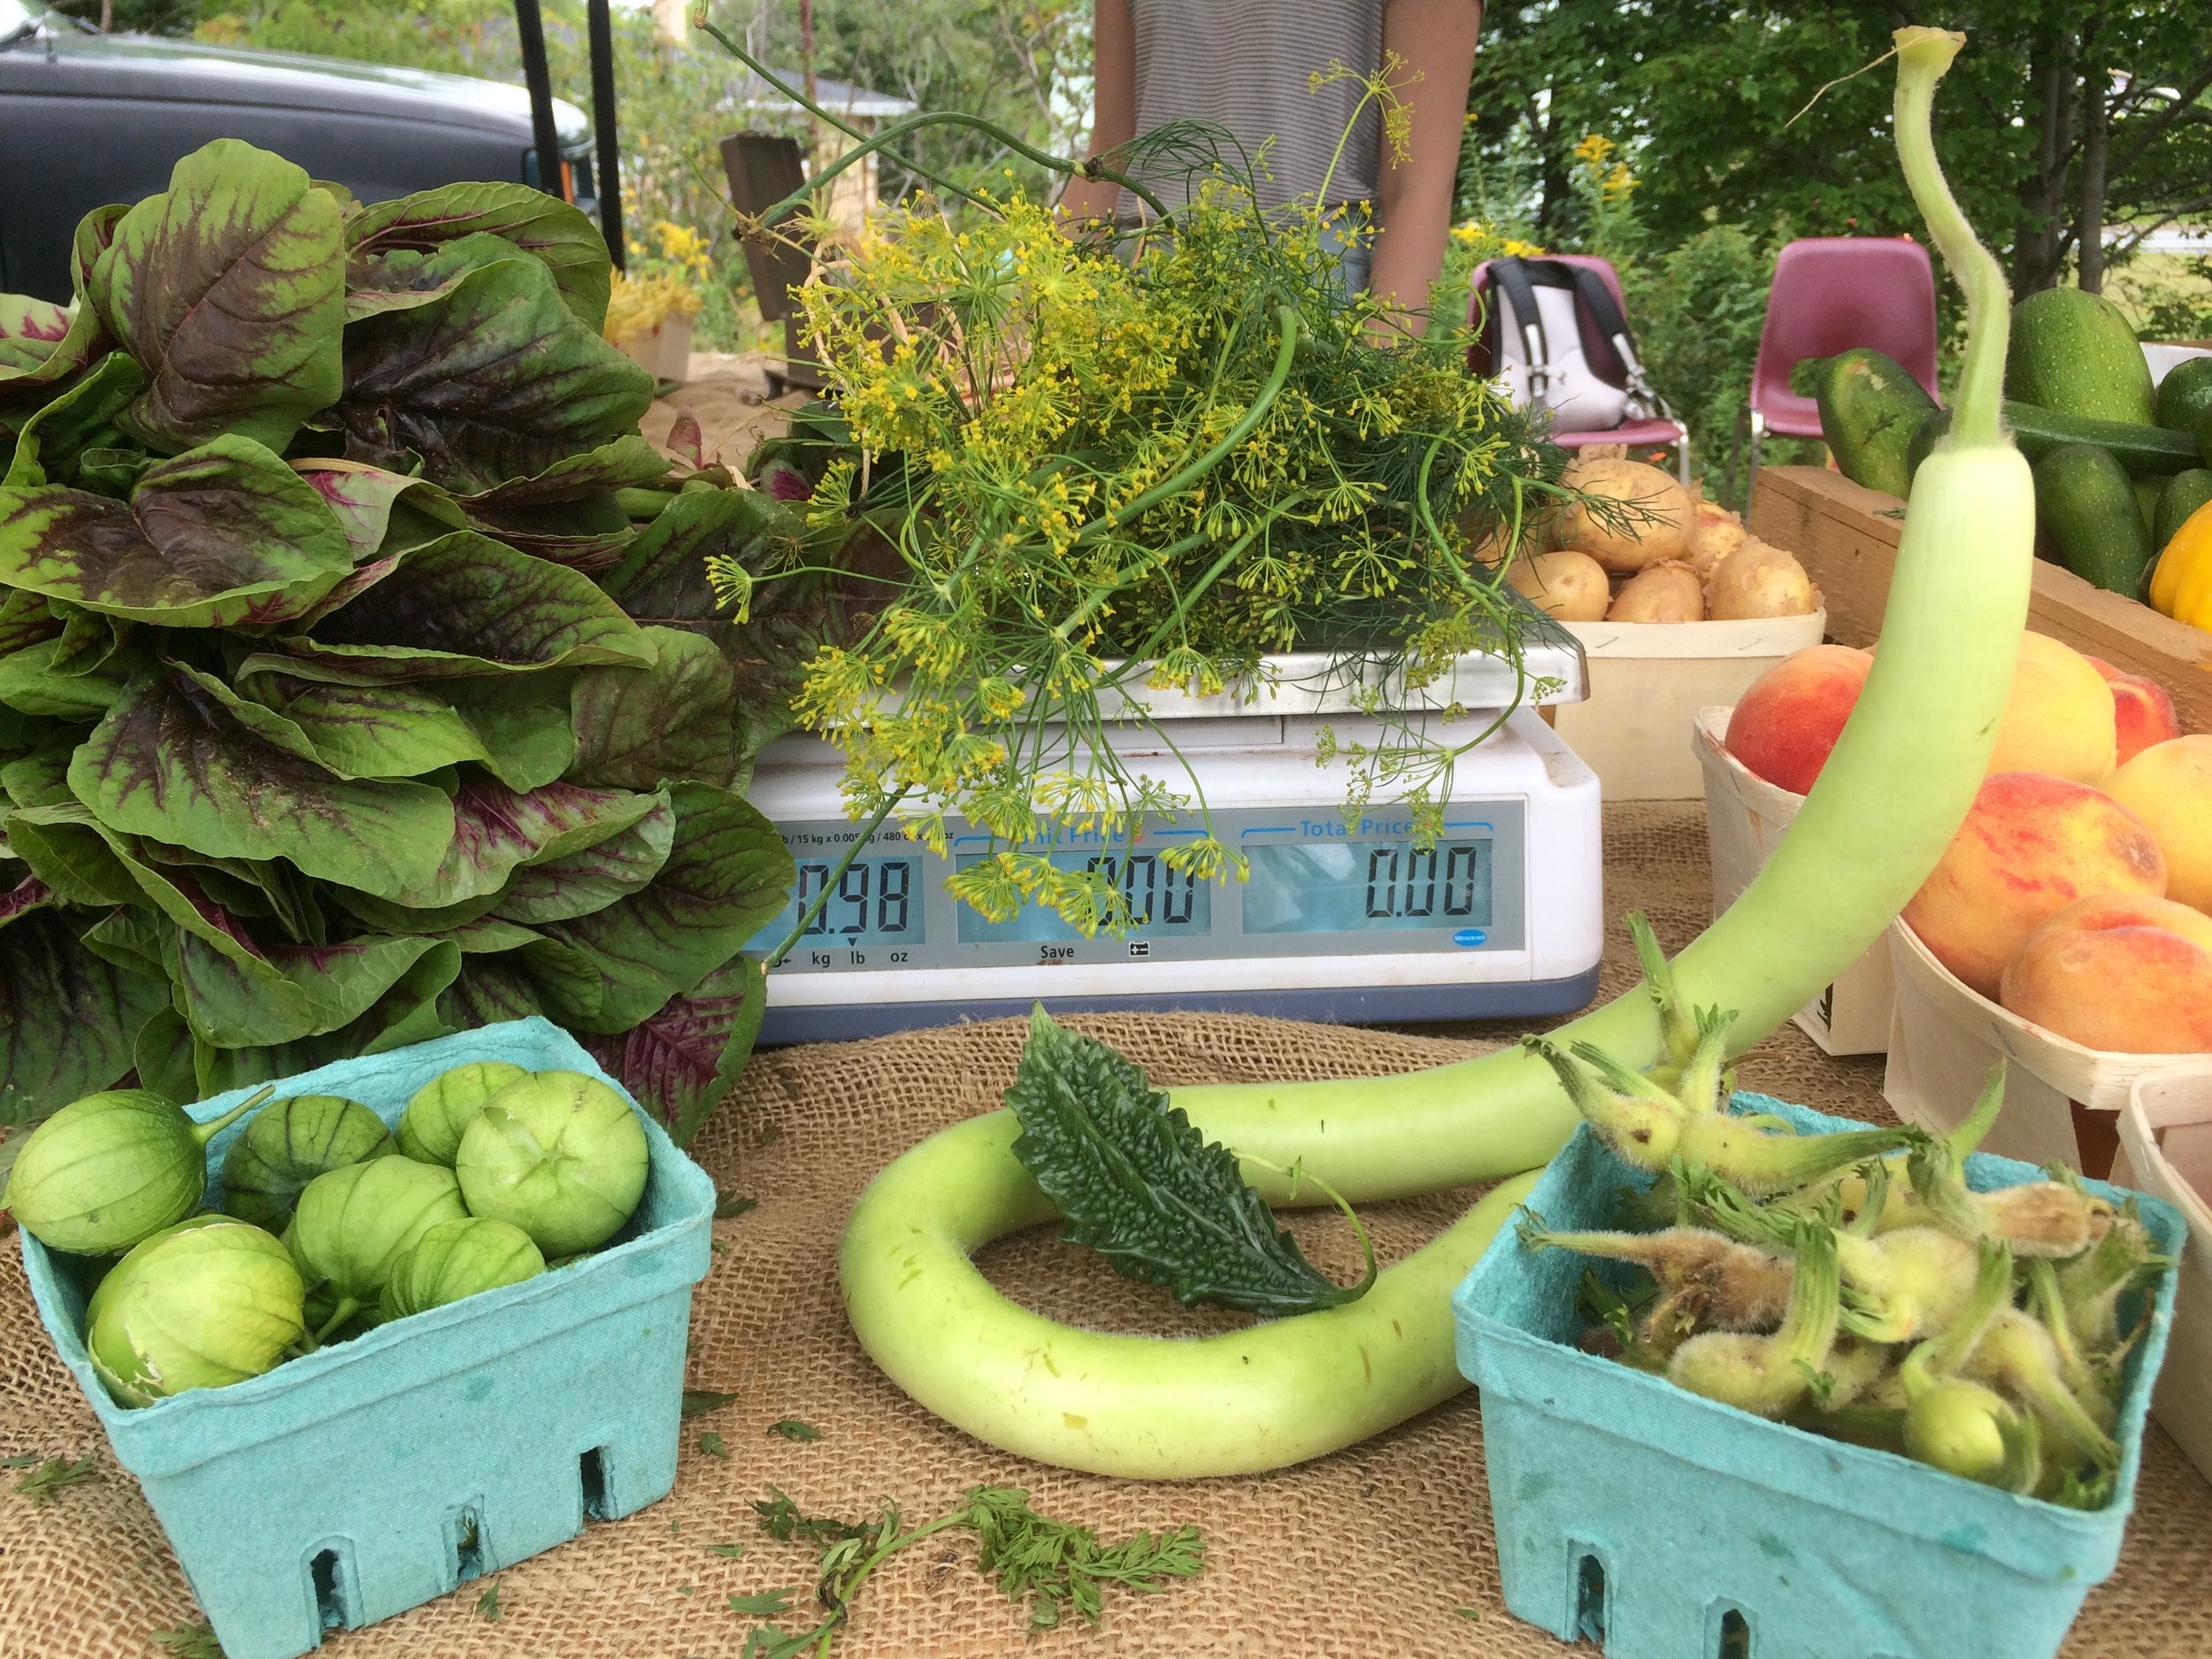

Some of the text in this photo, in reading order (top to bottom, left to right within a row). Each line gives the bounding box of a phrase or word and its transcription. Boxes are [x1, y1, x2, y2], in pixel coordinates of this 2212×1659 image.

[797, 833, 810, 844] 15
[811, 834, 824, 846] kg
[883, 832, 901, 841] 480
[1365, 846, 1477, 918] 0.00
[798, 862, 910, 935] 0.98
[811, 951, 909, 968] kg lb oz
[1041, 945, 1075, 959] Save
